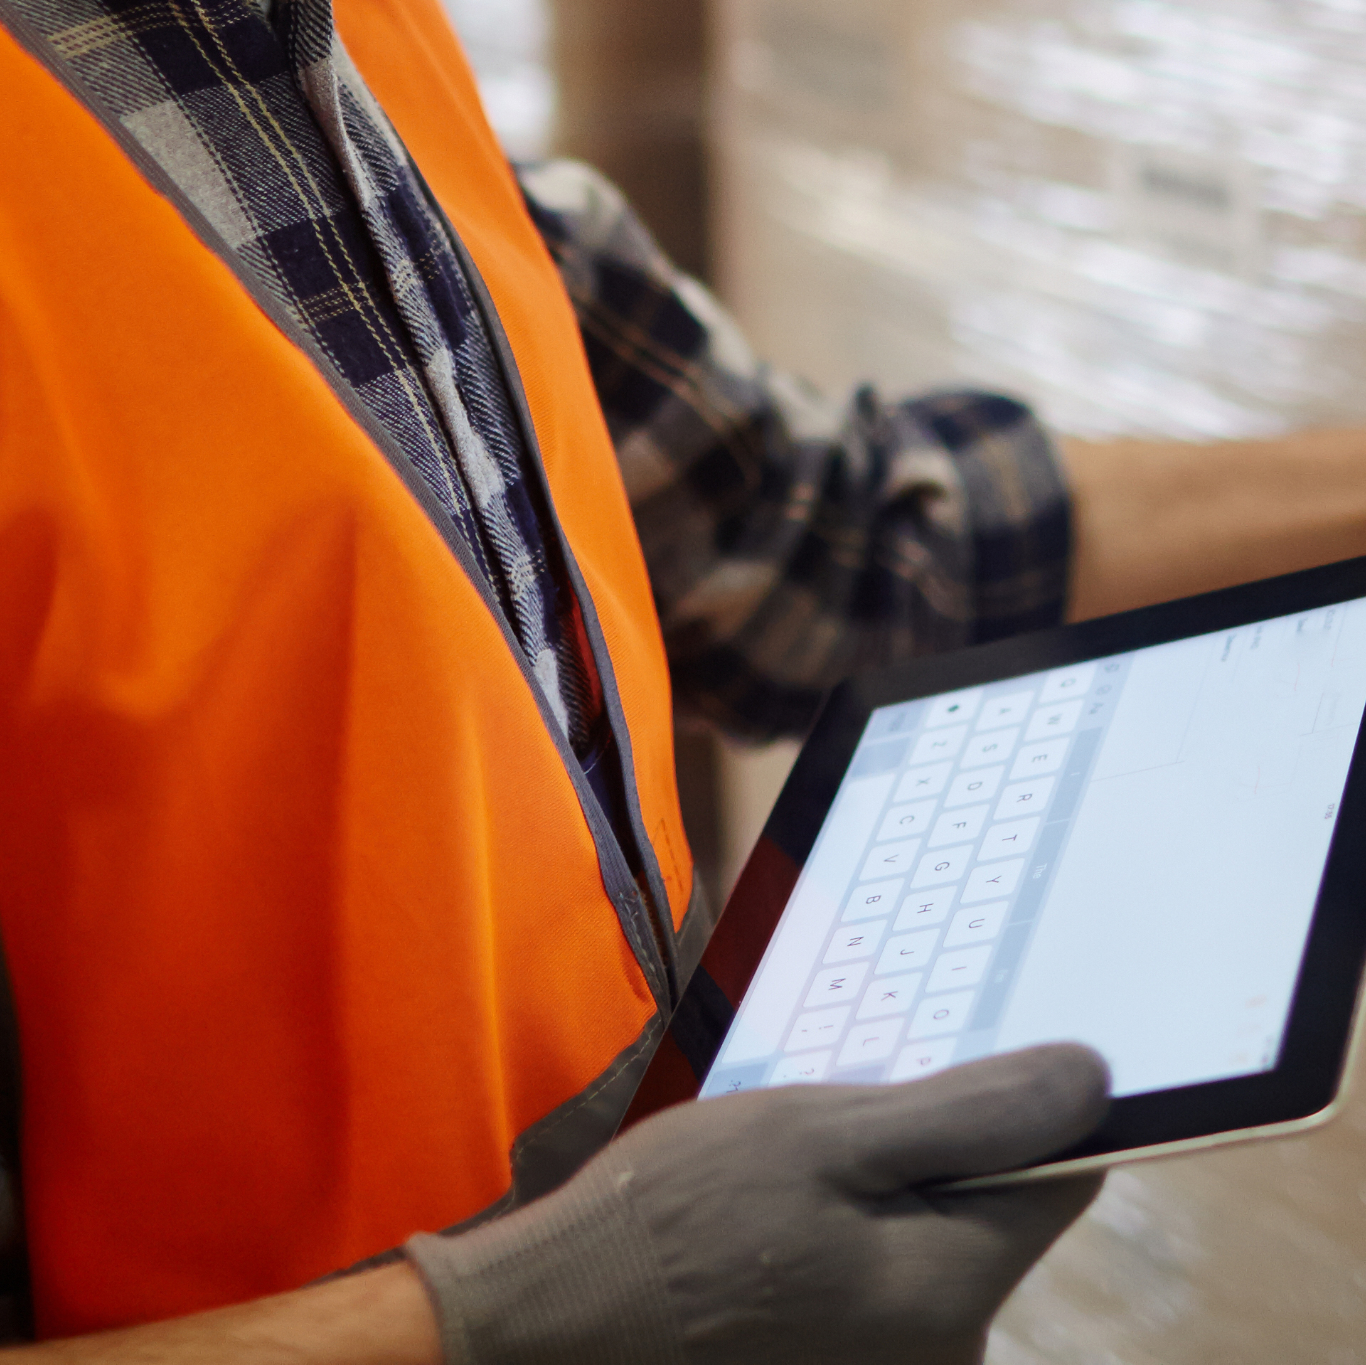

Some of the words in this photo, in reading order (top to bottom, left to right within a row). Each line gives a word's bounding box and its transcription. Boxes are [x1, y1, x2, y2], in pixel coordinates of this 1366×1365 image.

[999, 706, 1012, 715] A
[1047, 713, 1063, 725] W
[931, 740, 947, 749] Z
[982, 743, 998, 753] S
[1032, 754, 1048, 762] E
[917, 778, 931, 786] X
[967, 781, 983, 791] D
[1017, 793, 1033, 802] R
[899, 816, 915, 826] C
[951, 821, 967, 830] F
[1001, 834, 1017, 842] T
[883, 854, 899, 864] V
[934, 861, 950, 872] G
[1033, 863, 1048, 880] The
[985, 875, 1002, 884] Y
[865, 895, 882, 905] B
[917, 902, 934, 914] H
[968, 918, 985, 928] U
[847, 936, 865, 947] N
[899, 948, 915, 956] J
[828, 978, 847, 990] M
[881, 990, 899, 1001] K
[933, 1009, 949, 1020] O
[862, 1036, 880, 1046] L
[916, 1057, 931, 1066] P
[799, 1068, 815, 1076] ?
